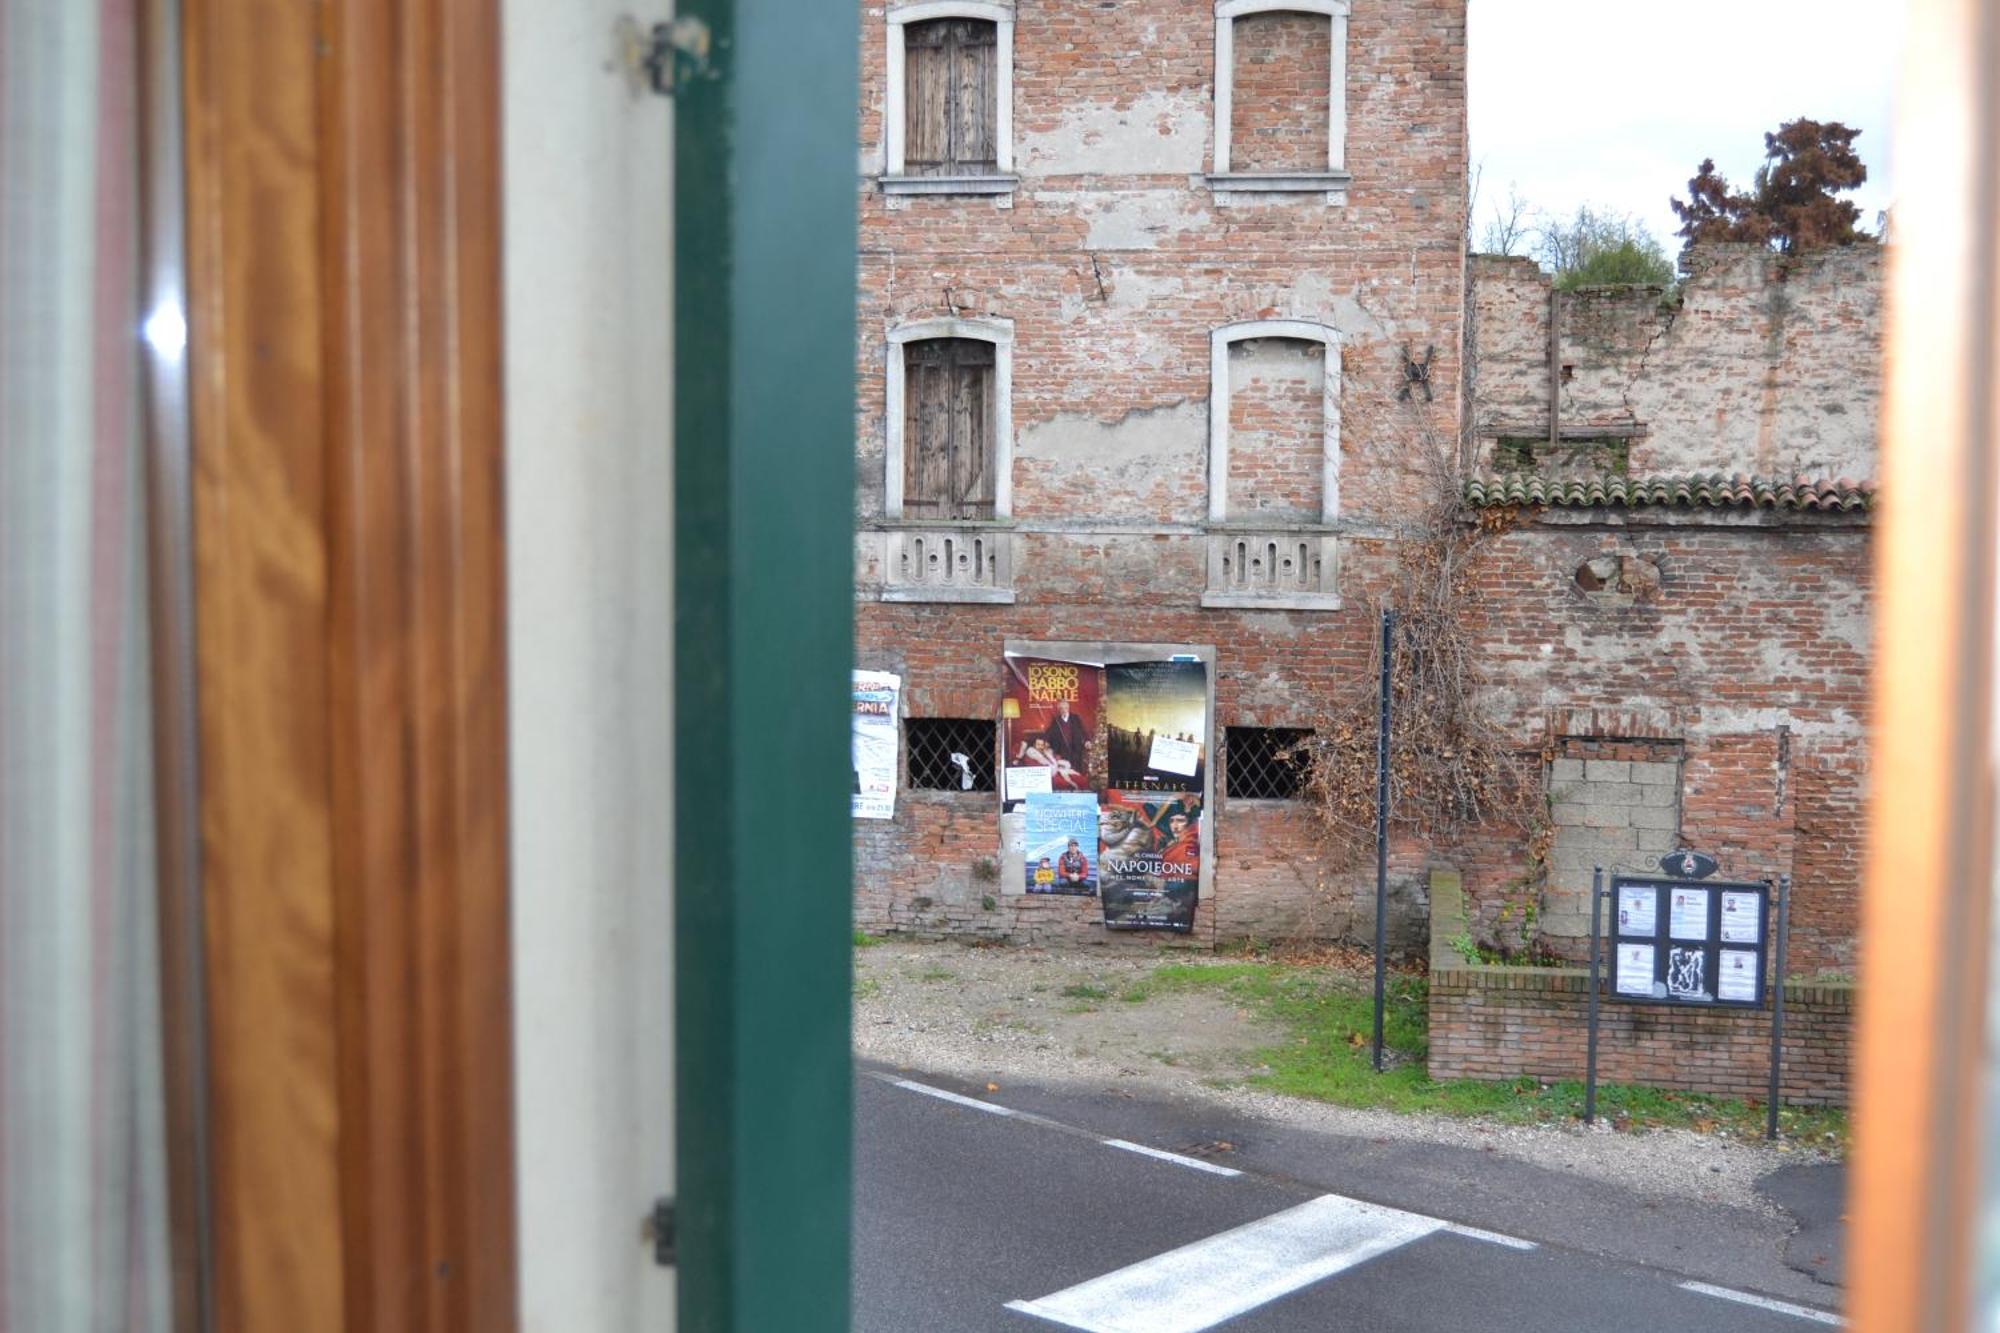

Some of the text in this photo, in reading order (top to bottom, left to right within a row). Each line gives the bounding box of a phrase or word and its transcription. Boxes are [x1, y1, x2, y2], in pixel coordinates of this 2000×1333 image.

[1028, 666, 1078, 678] IO SONO
[1028, 676, 1080, 690] BABBO
[1028, 689, 1080, 702] NATALE
[1036, 808, 1088, 819] NOWHERE
[1036, 818, 1088, 833] SPECIAL
[1107, 859, 1193, 876] NAPOLEONE
